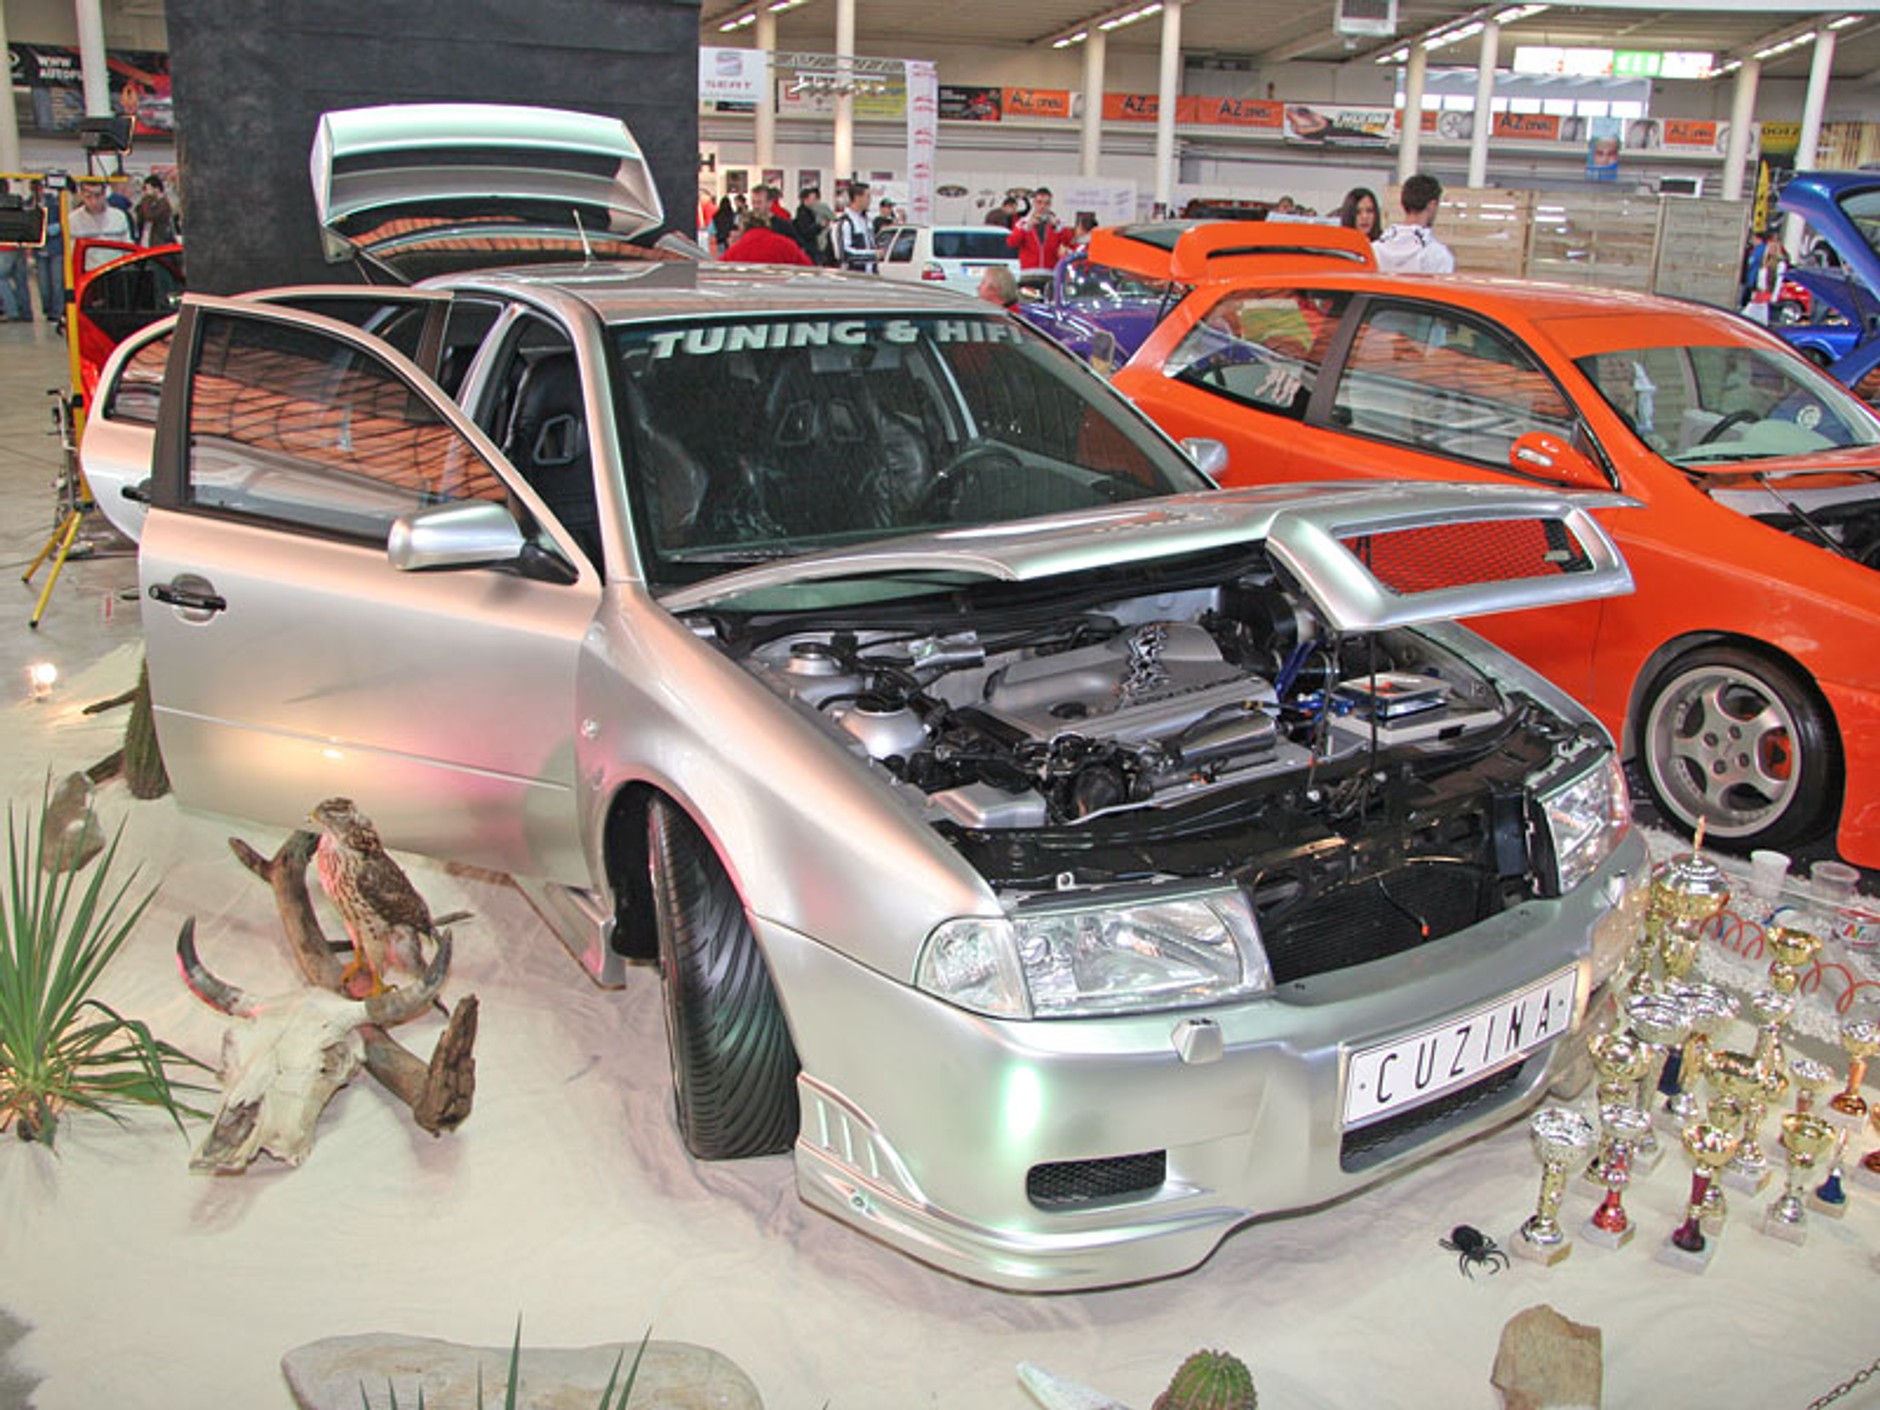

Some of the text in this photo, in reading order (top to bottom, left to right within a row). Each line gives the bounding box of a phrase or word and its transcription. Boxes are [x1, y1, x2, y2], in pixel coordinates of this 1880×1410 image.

[1123, 95, 1147, 112] AZ
[1218, 99, 1242, 116] AZ
[649, 321, 866, 359] TUNING
[886, 320, 917, 342] &
[1376, 989, 1552, 1104] CUZINA
